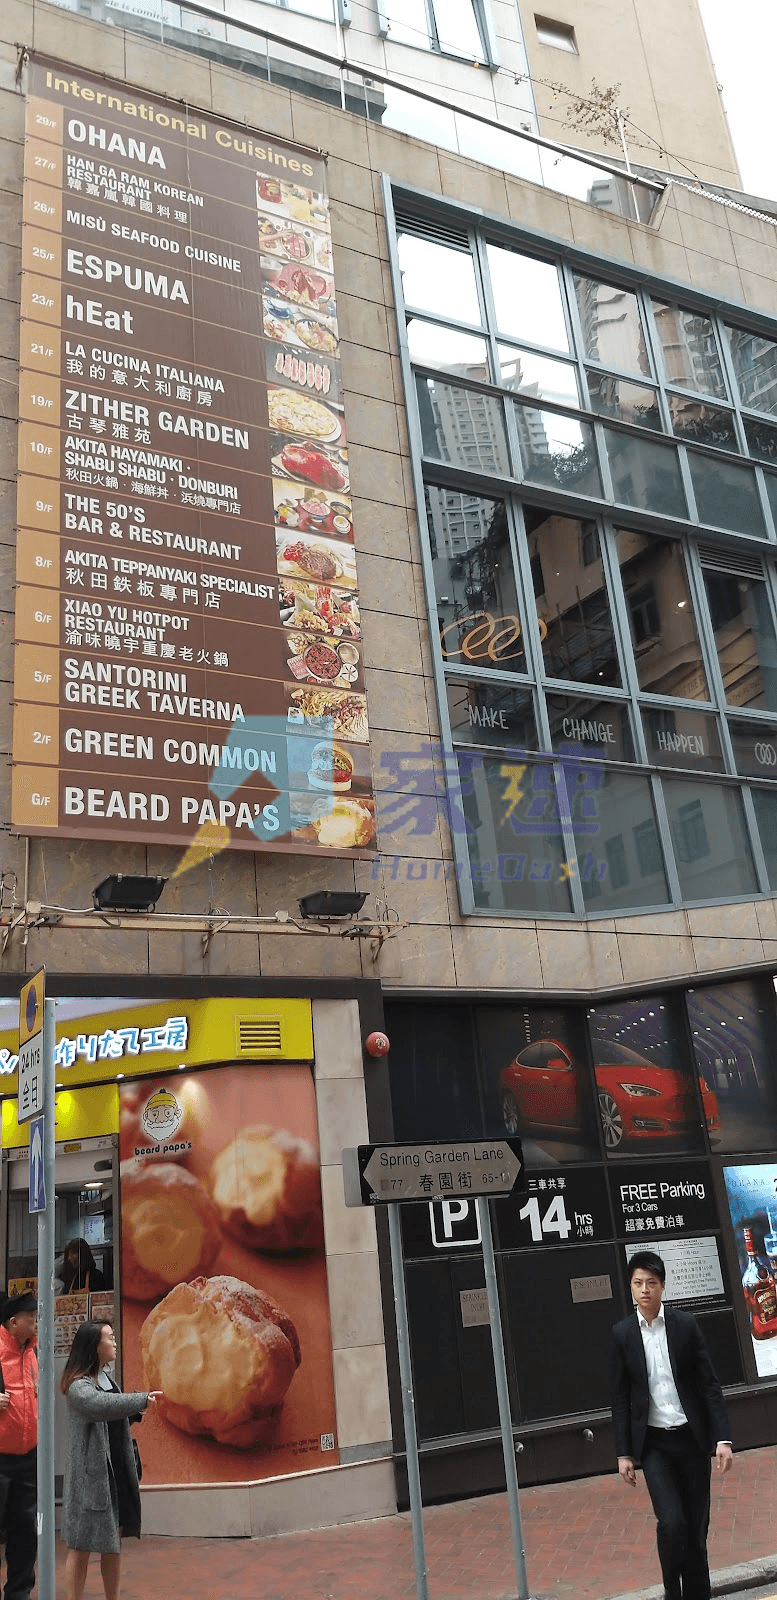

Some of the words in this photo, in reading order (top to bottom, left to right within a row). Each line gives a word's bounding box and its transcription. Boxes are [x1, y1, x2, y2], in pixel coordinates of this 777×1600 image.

[36, 114, 57, 128] 29/F
[46, 71, 207, 140] International
[215, 130, 313, 177] Cuisines
[67, 119, 166, 169] OHANA
[34, 156, 57, 170] 27/F
[66, 155, 95, 175] HAN
[99, 165, 117, 179] GA
[121, 171, 150, 189] RAM
[154, 182, 204, 207] KOREAN
[67, 166, 152, 200] RESTAURANT
[33, 200, 56, 215] 26/F
[32, 246, 55, 262] 25/F
[111, 221, 180, 254] SEAFOOD
[185, 245, 242, 273] CUISINE
[66, 249, 190, 305] ESPUMA
[31, 292, 55, 307] 23/F
[66, 294, 134, 335] hEat
[31, 342, 54, 357] 21/F
[65, 341, 87, 358] LA
[91, 348, 151, 375] CUCINA
[155, 364, 225, 394] ITALIANA
[66, 358, 214, 407] 我的意大利廚房
[30, 394, 54, 408] 19/F
[65, 388, 150, 426] ZITHER
[158, 410, 250, 450] GARDEN
[66, 413, 152, 445] 古琴雅苑
[29, 441, 53, 455] 10/F
[65, 436, 108, 457] AKITA
[111, 445, 183, 473] HAYAMAKI
[65, 451, 116, 474] SHABU
[118, 461, 166, 484] SHABU
[178, 476, 238, 500] DONBURI
[35, 499, 53, 513] 9/F
[65, 493, 100, 515] THE
[65, 513, 103, 535] BAR
[109, 522, 124, 539] &
[129, 524, 242, 561] RESTAURANT
[35, 555, 53, 569] 8/F
[65, 550, 108, 570] AKITA
[111, 557, 197, 586] TEPPANYAKI
[200, 573, 275, 600] SPECIALIST
[65, 567, 221, 610] 秋田鉄板專門店
[34, 610, 52, 624] 6/F
[65, 599, 102, 617] XIAO
[108, 605, 127, 620] YU
[132, 608, 190, 631] HOTPOT
[65, 614, 166, 643] RESTAURANT
[65, 628, 229, 668] 渝味曉宇重慶老火鍋
[33, 671, 52, 684] 5/F
[64, 658, 187, 693] SANTORINI
[65, 681, 141, 710] GREEK
[147, 691, 246, 723] TAVERNA
[33, 731, 52, 745] 2/F
[469, 705, 510, 730] MAKE
[562, 718, 616, 743] CHANGE
[657, 731, 705, 756] HAPPEN
[65, 727, 154, 760] GREEN
[164, 738, 277, 773] COMMON
[31, 793, 51, 807] G/F
[65, 786, 169, 823] BEARD
[182, 797, 280, 831] PAPA'S
[22, 1050, 29, 1074] 24
[30, 1047, 40, 1069] hrs
[134, 1144, 160, 1156] beard
[163, 1141, 192, 1154] papa's
[380, 1152, 420, 1168] Spring
[424, 1149, 470, 1164] Garden
[473, 1147, 504, 1161] Lane
[419, 1171, 472, 1192] 春園街
[528, 1177, 566, 1192] 三車共享
[620, 1183, 658, 1201] FREE
[660, 1181, 705, 1199] Parking
[442, 1199, 469, 1238] P
[519, 1195, 572, 1242] 14
[574, 1211, 593, 1226] hrs
[622, 1203, 634, 1213] For
[635, 1202, 641, 1212] 3
[641, 1202, 658, 1212] Cars
[576, 1224, 594, 1238] 小時
[624, 1214, 685, 1232] 超豪免費泊車
